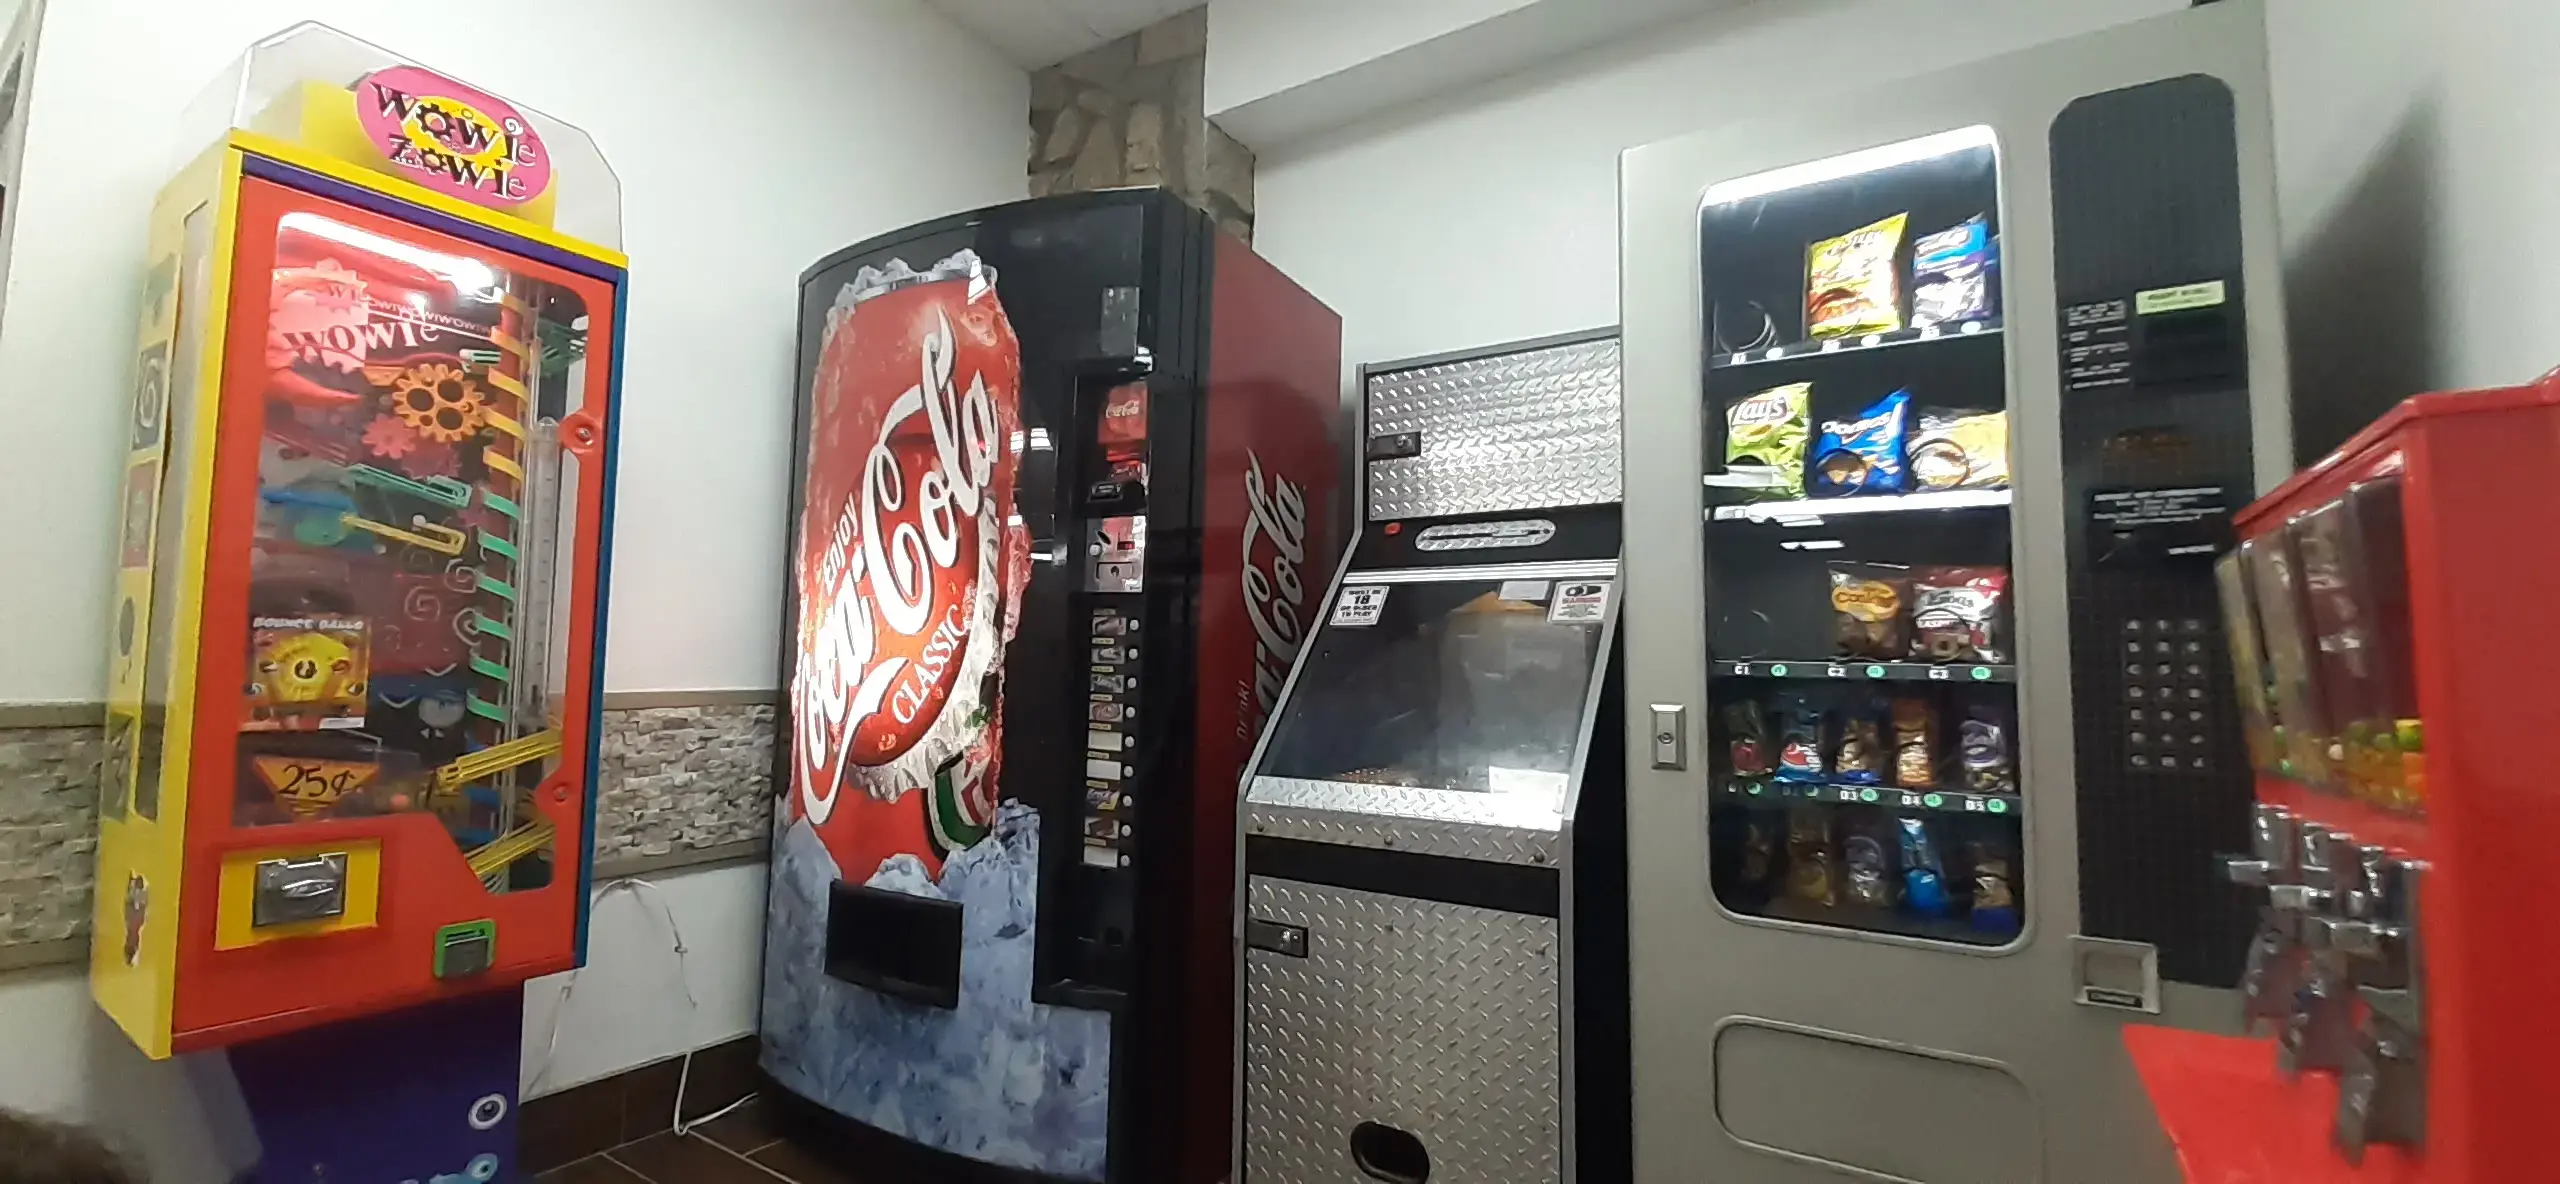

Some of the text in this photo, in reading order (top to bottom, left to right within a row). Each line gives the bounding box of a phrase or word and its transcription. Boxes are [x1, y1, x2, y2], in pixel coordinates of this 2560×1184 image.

[801, 304, 999, 826] Coca-Cola
[823, 492, 860, 588] Enjoy
[1354, 594, 1371, 605] 18
[892, 602, 970, 725] CLASSIC
[279, 764, 355, 798] 25¢
